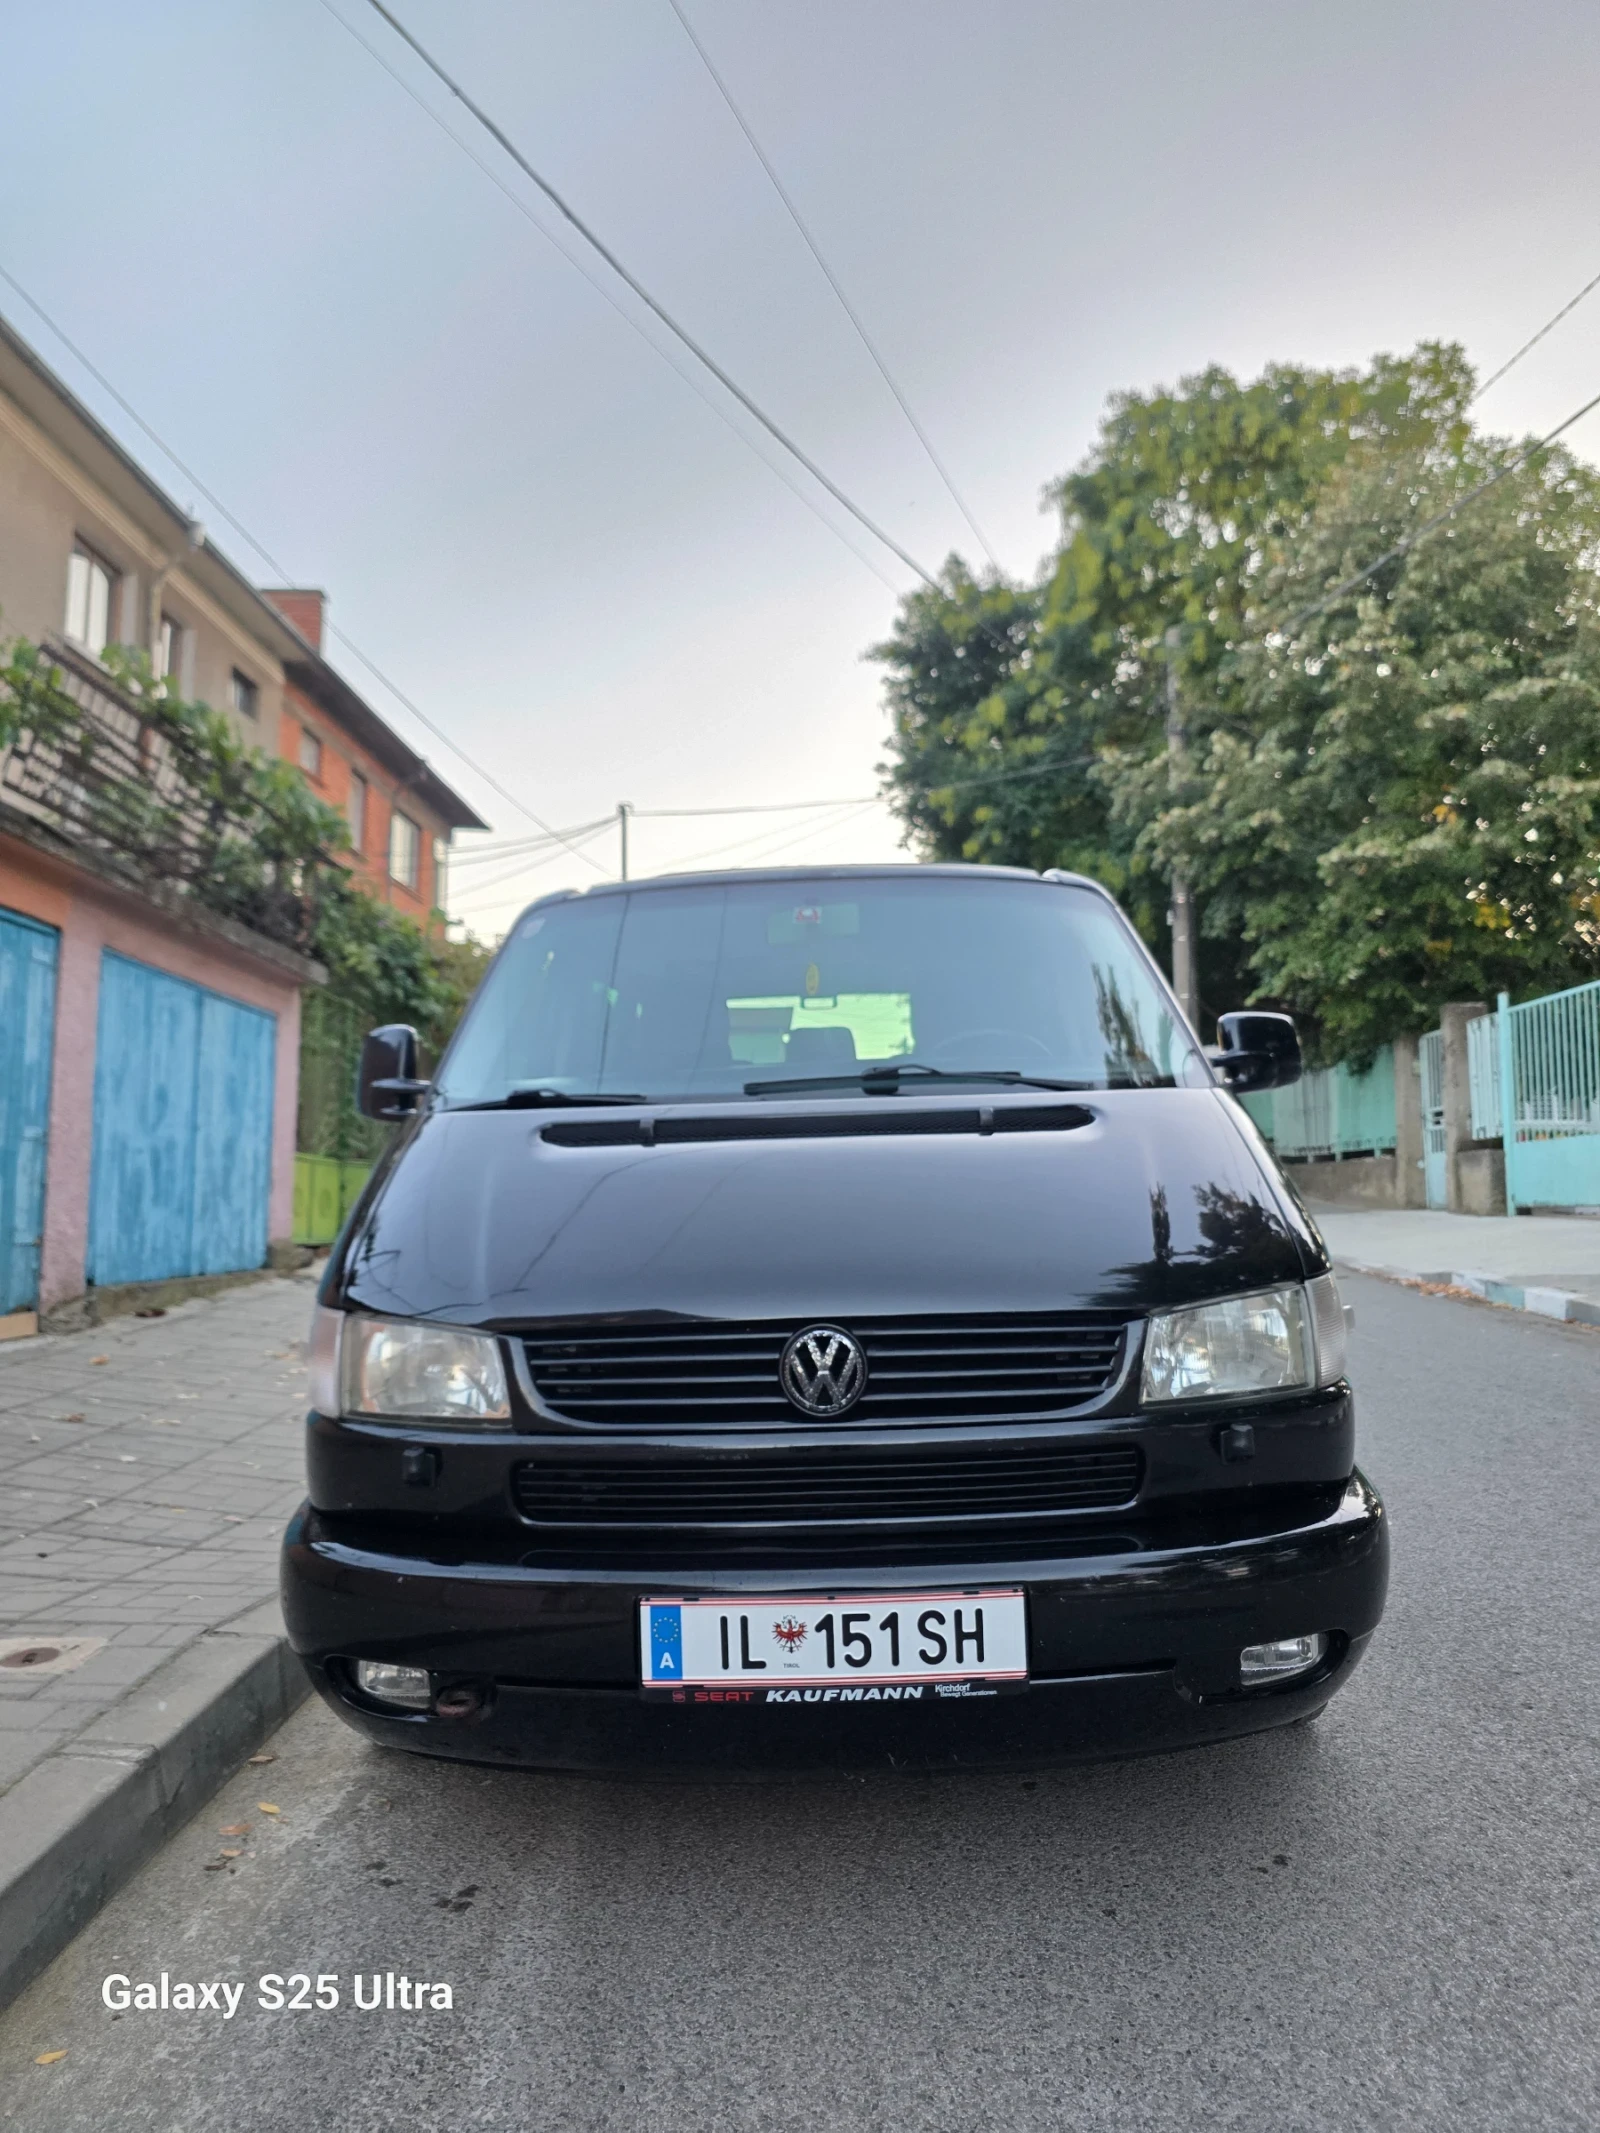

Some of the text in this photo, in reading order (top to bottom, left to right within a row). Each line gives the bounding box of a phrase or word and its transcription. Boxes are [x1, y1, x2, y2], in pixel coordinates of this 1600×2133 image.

[720, 1614, 767, 1670] IL
[659, 1652, 675, 1669] A
[765, 1686, 924, 1703] KAUFMANN
[934, 1682, 971, 1693] Kirchdorf
[694, 1691, 754, 1702] SEAT
